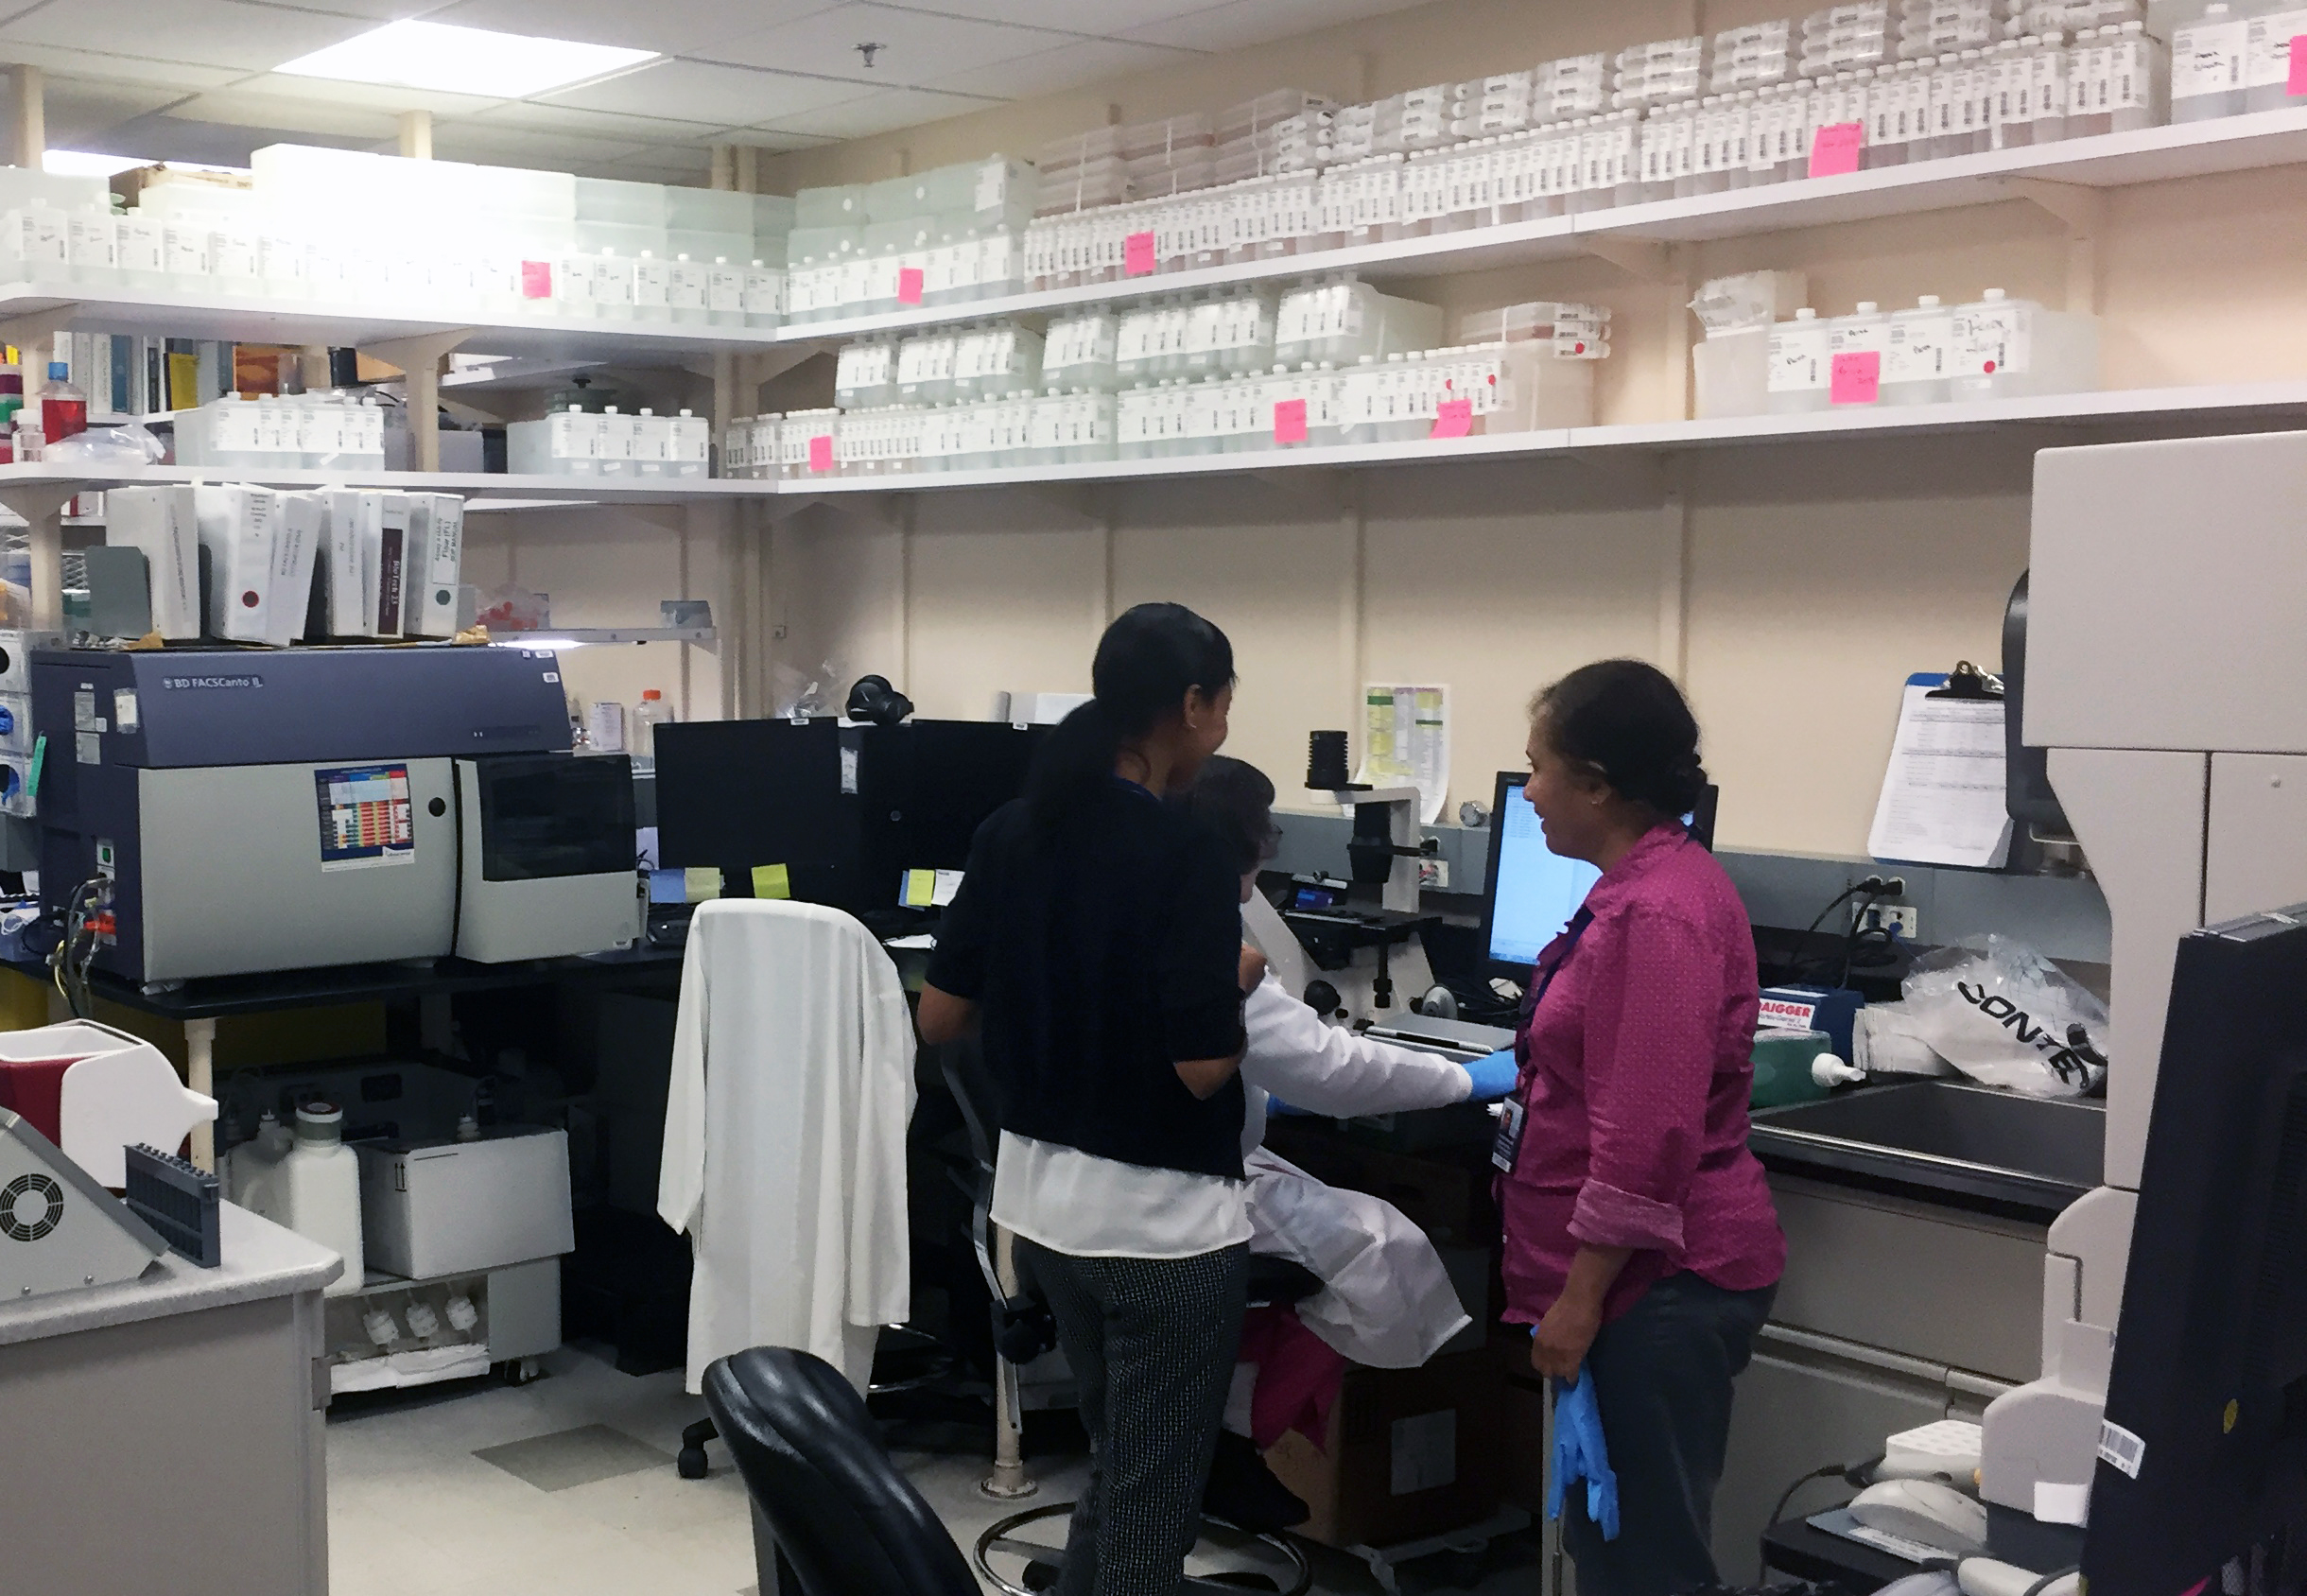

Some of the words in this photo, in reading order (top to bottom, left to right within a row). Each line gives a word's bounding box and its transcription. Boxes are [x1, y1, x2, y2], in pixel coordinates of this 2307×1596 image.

[174, 678, 190, 688] BD
[192, 677, 250, 688] FACSCanto
[1759, 1002, 1811, 1017] AIGGER
